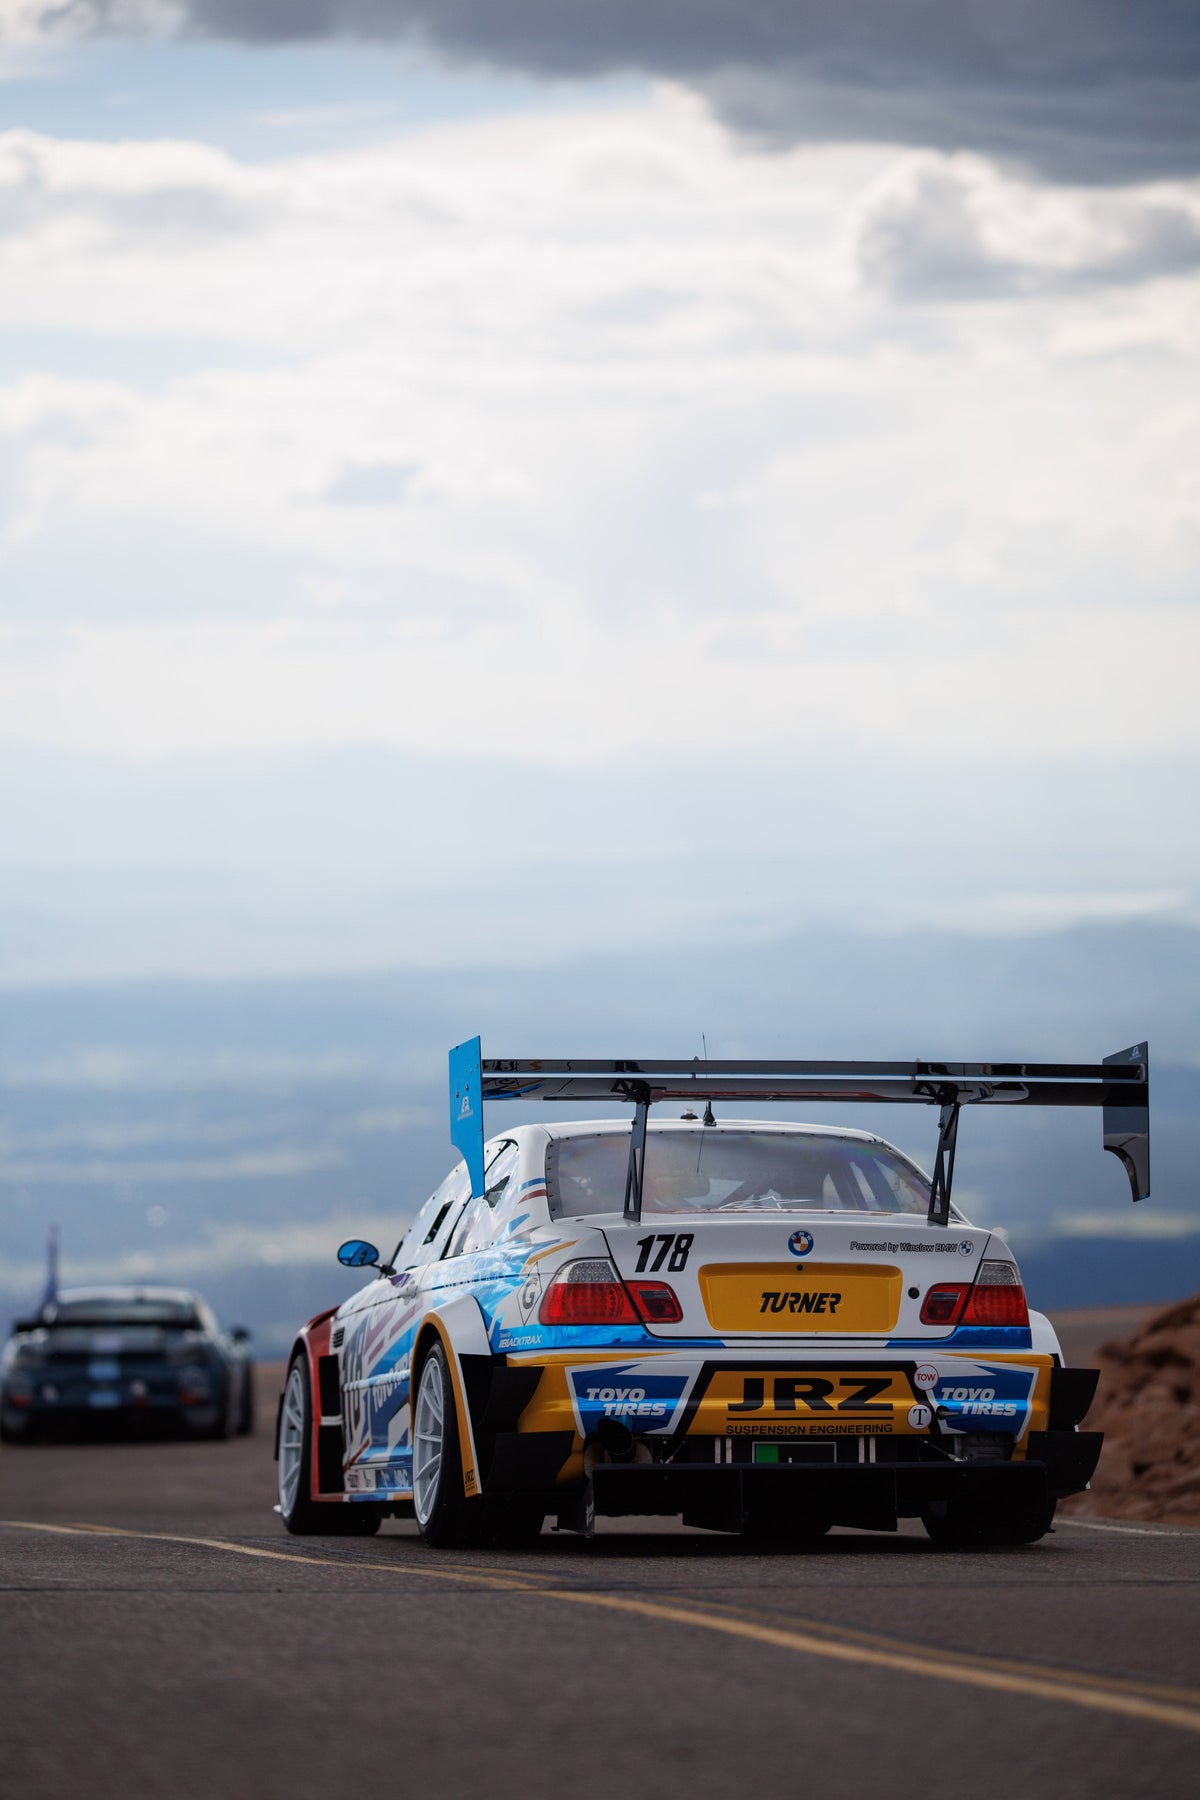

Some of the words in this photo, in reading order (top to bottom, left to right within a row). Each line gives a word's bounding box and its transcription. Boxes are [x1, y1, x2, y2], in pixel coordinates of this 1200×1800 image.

[634, 1233, 695, 1272] 178
[850, 1241, 887, 1251] Powered
[888, 1242, 899, 1253] by
[900, 1243, 934, 1252] Winslow
[935, 1243, 958, 1252] BMW
[522, 1277, 538, 1310] G
[760, 1292, 842, 1313] TURNER
[917, 1373, 936, 1382] TOW
[586, 1388, 646, 1402] TOYO
[728, 1378, 894, 1412] JRZ
[941, 1388, 996, 1402] TOYO
[603, 1403, 667, 1416] TIRES
[960, 1402, 1017, 1417] TIRES
[913, 1409, 928, 1426] T
[726, 1425, 806, 1435] SUSPENSION
[809, 1424, 893, 1434] ENGINEERING
